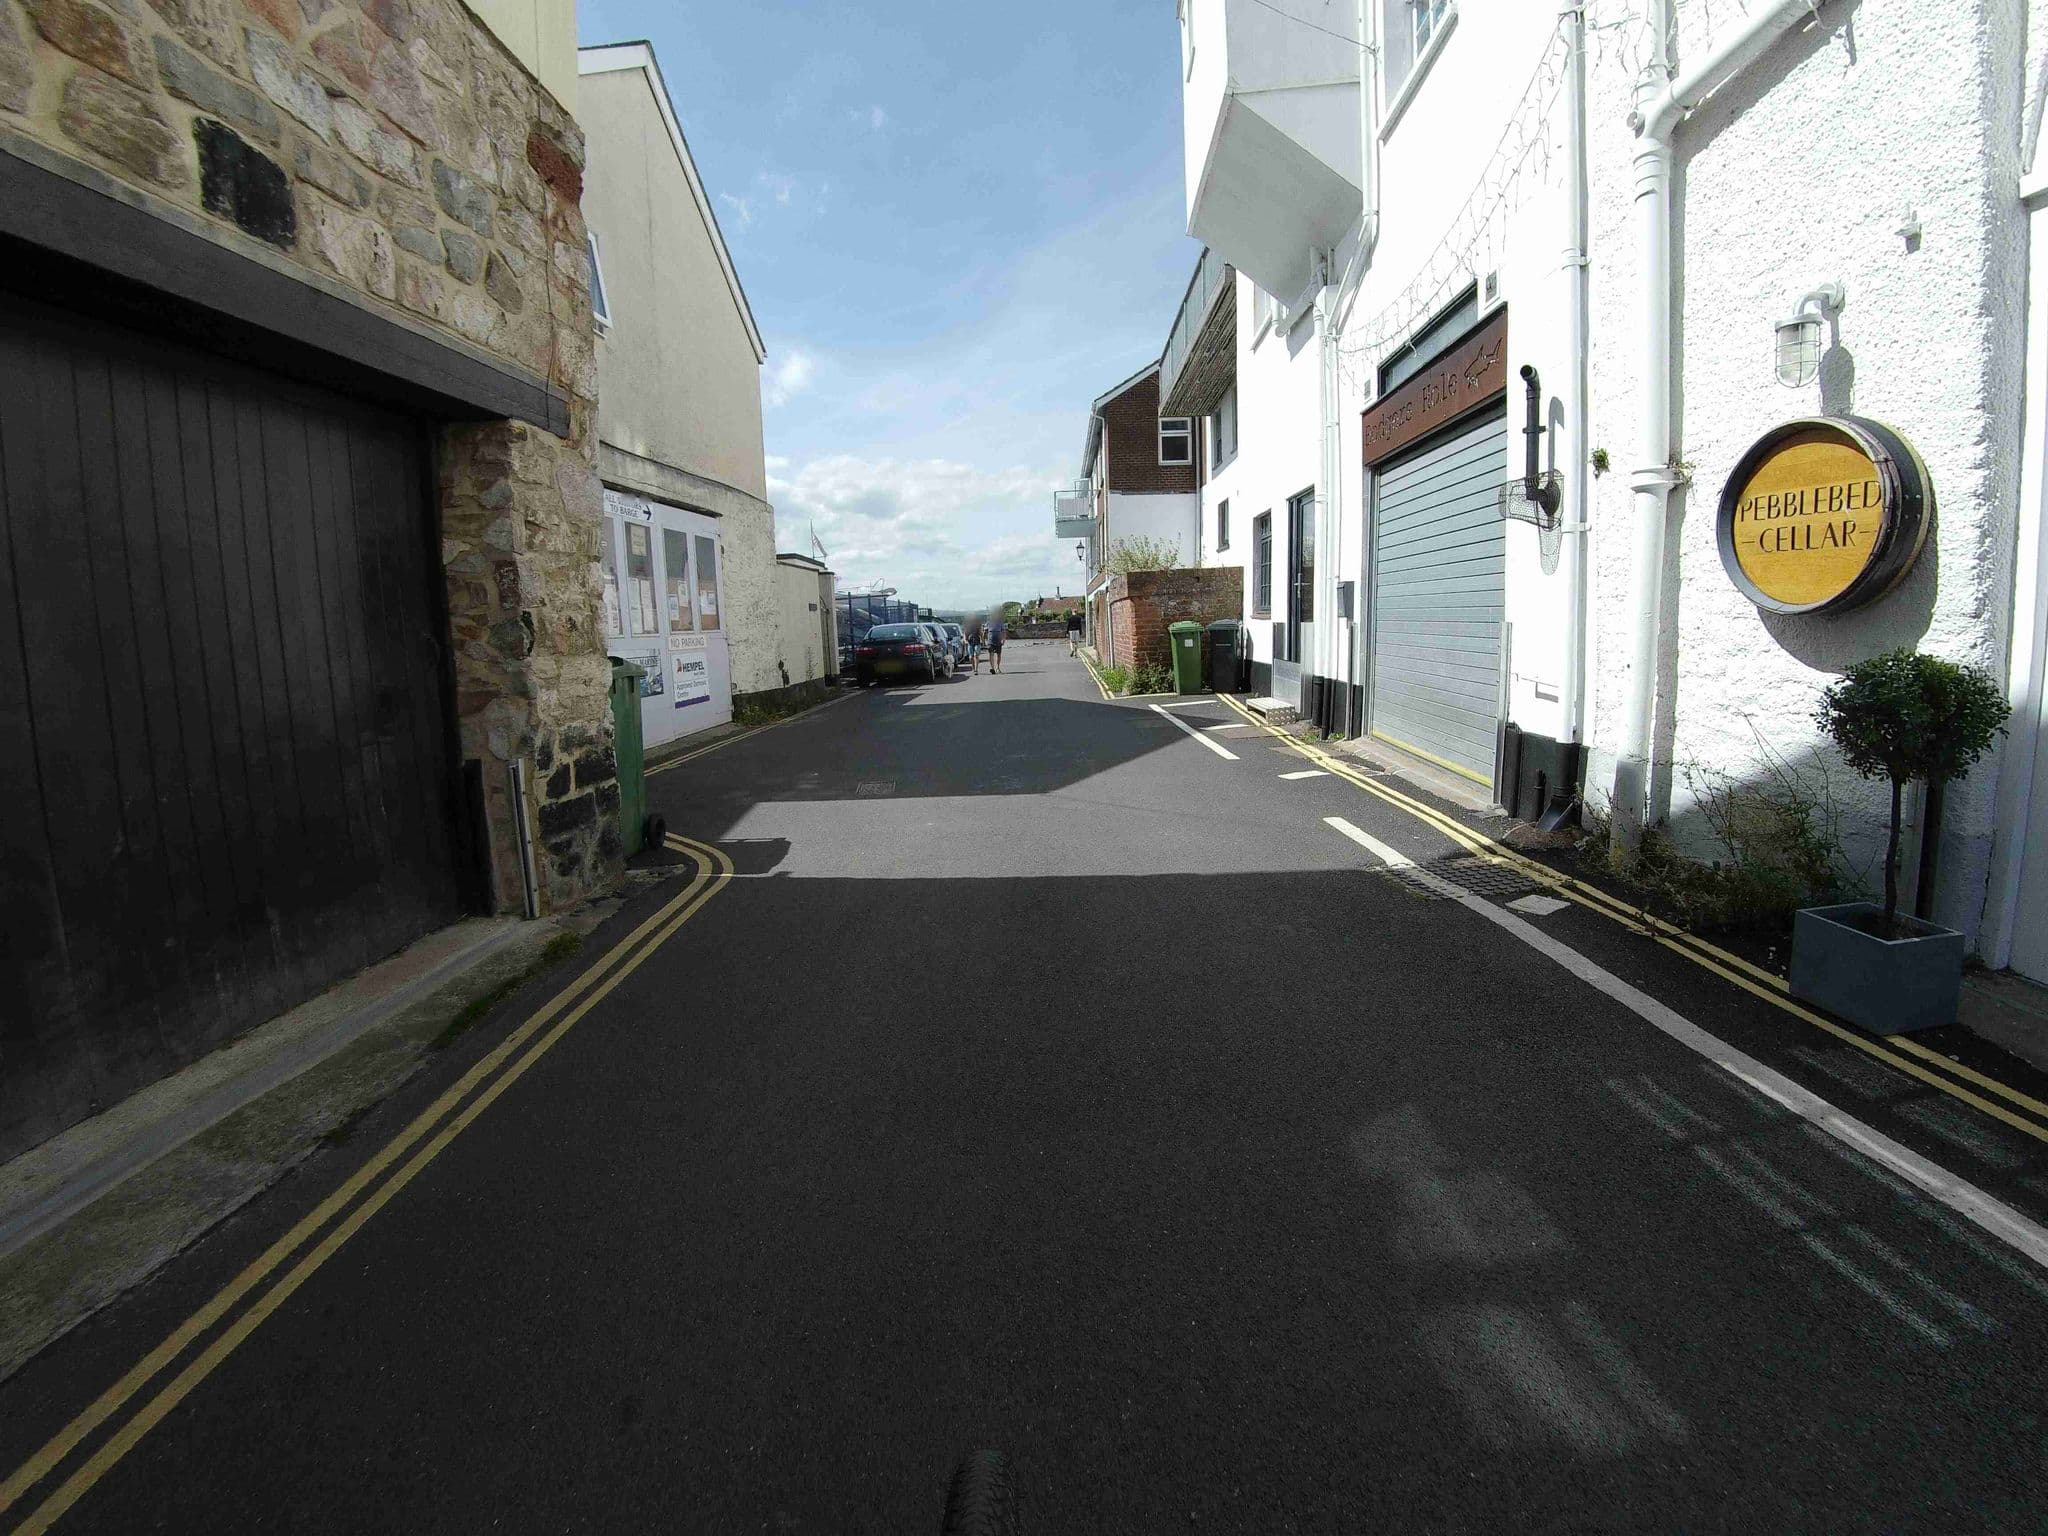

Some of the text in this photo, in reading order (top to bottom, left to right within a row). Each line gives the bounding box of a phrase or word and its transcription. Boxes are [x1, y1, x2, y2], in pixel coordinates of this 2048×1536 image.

[1740, 480, 1882, 522] PEBBLEBED
[670, 636, 705, 648] NO PARKING
[682, 661, 705, 673] HEMPEL
